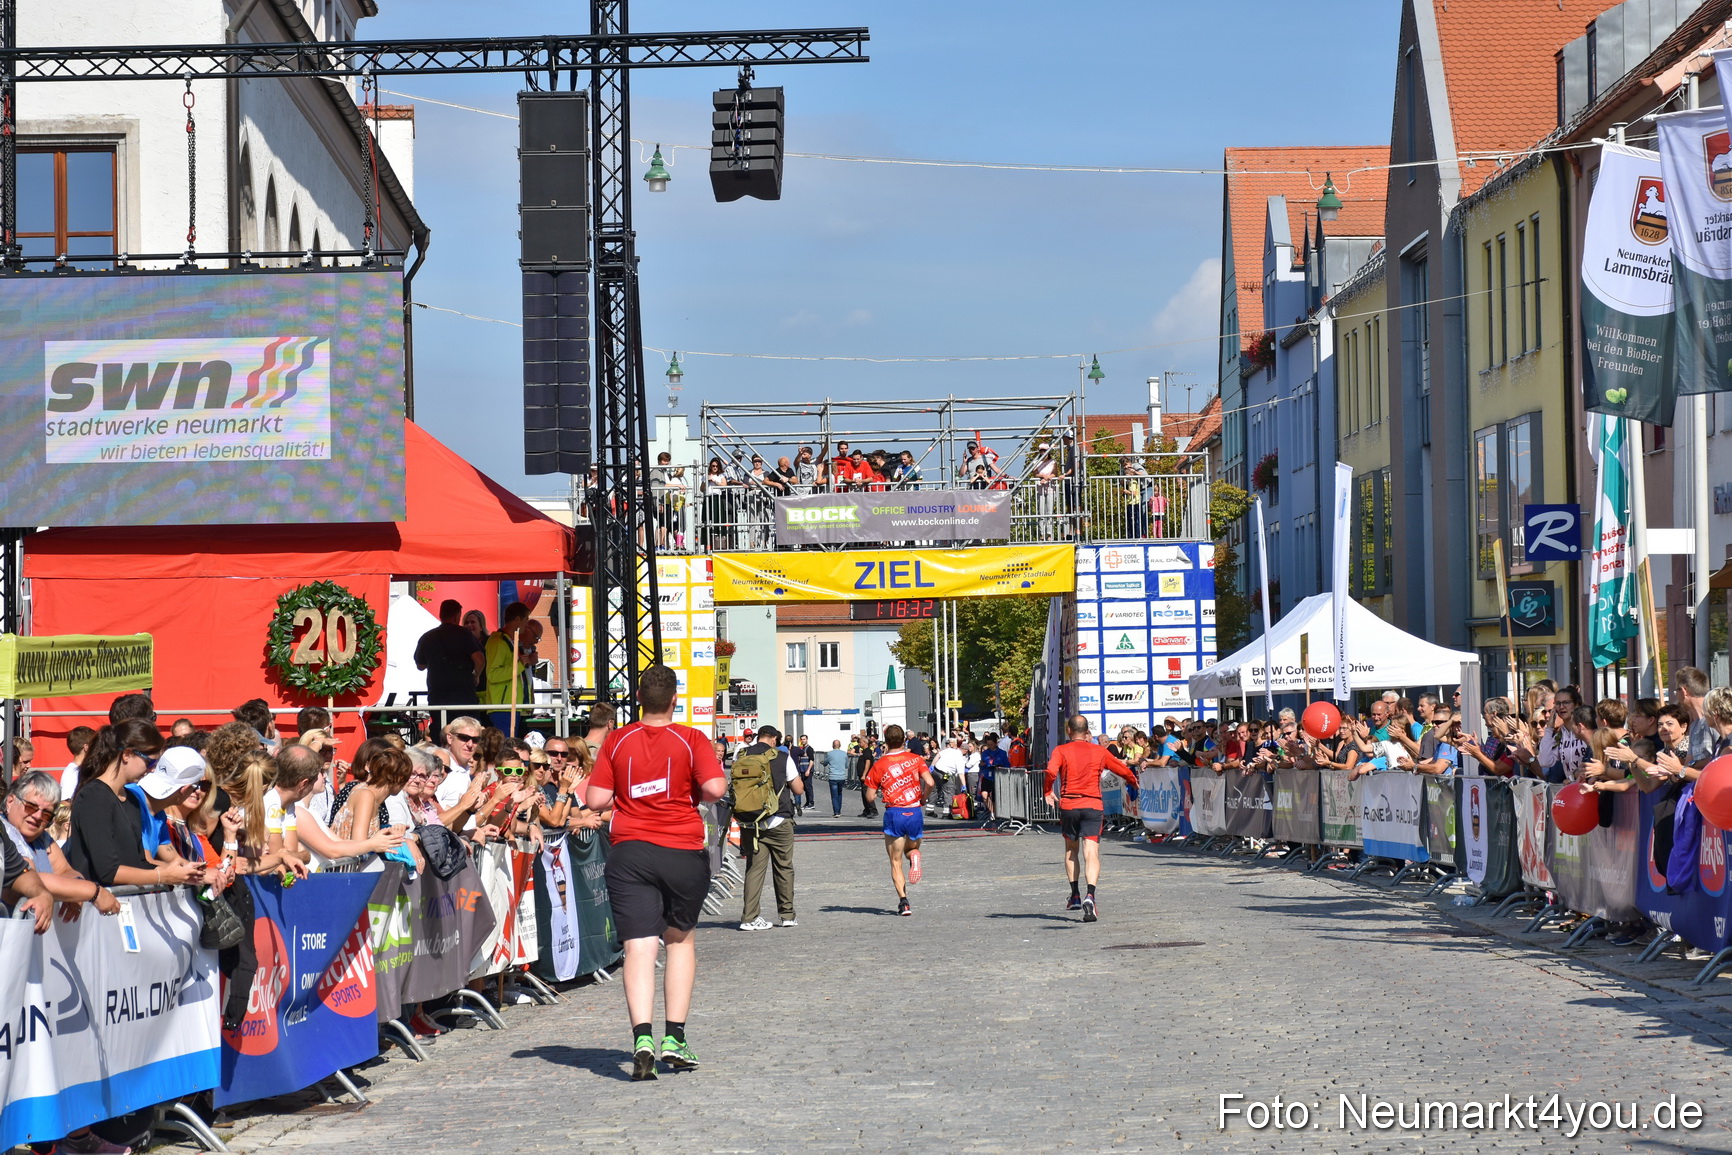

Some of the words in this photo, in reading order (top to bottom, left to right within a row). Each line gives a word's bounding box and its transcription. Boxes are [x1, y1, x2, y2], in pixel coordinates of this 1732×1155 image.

[1640, 228, 1660, 240] 1628
[1617, 248, 1670, 268] Neumarkter
[1596, 324, 1657, 347] Willkommen
[1587, 338, 1600, 352] bei
[1604, 342, 1623, 356] den
[1626, 346, 1662, 364] BioBier
[1598, 357, 1644, 375] Freunden
[47, 361, 233, 413] swn
[46, 416, 168, 437] stadtwerke
[176, 415, 283, 435] neumarkt
[100, 444, 127, 461] wir
[131, 442, 187, 460] bieten
[194, 440, 324, 462] lebensqualität!
[787, 507, 857, 523] BOCK
[872, 506, 905, 516] OFFICE
[907, 505, 955, 515] INDUSTRY
[957, 504, 997, 513] LOUNGE
[891, 517, 980, 527] www.bockonline.de
[731, 578, 775, 586] Neumarkter
[854, 560, 935, 589] ZIEL
[979, 573, 1021, 581] Neumarkter
[1023, 570, 1056, 578] Stadtlauf
[876, 600, 935, 618] 1:18:32
[293, 607, 357, 665] 20
[17, 640, 150, 691] www.jumpers-fitness.com
[1107, 693, 1133, 701] swn
[302, 933, 327, 950] STORE
[331, 984, 362, 1007] SPORTS
